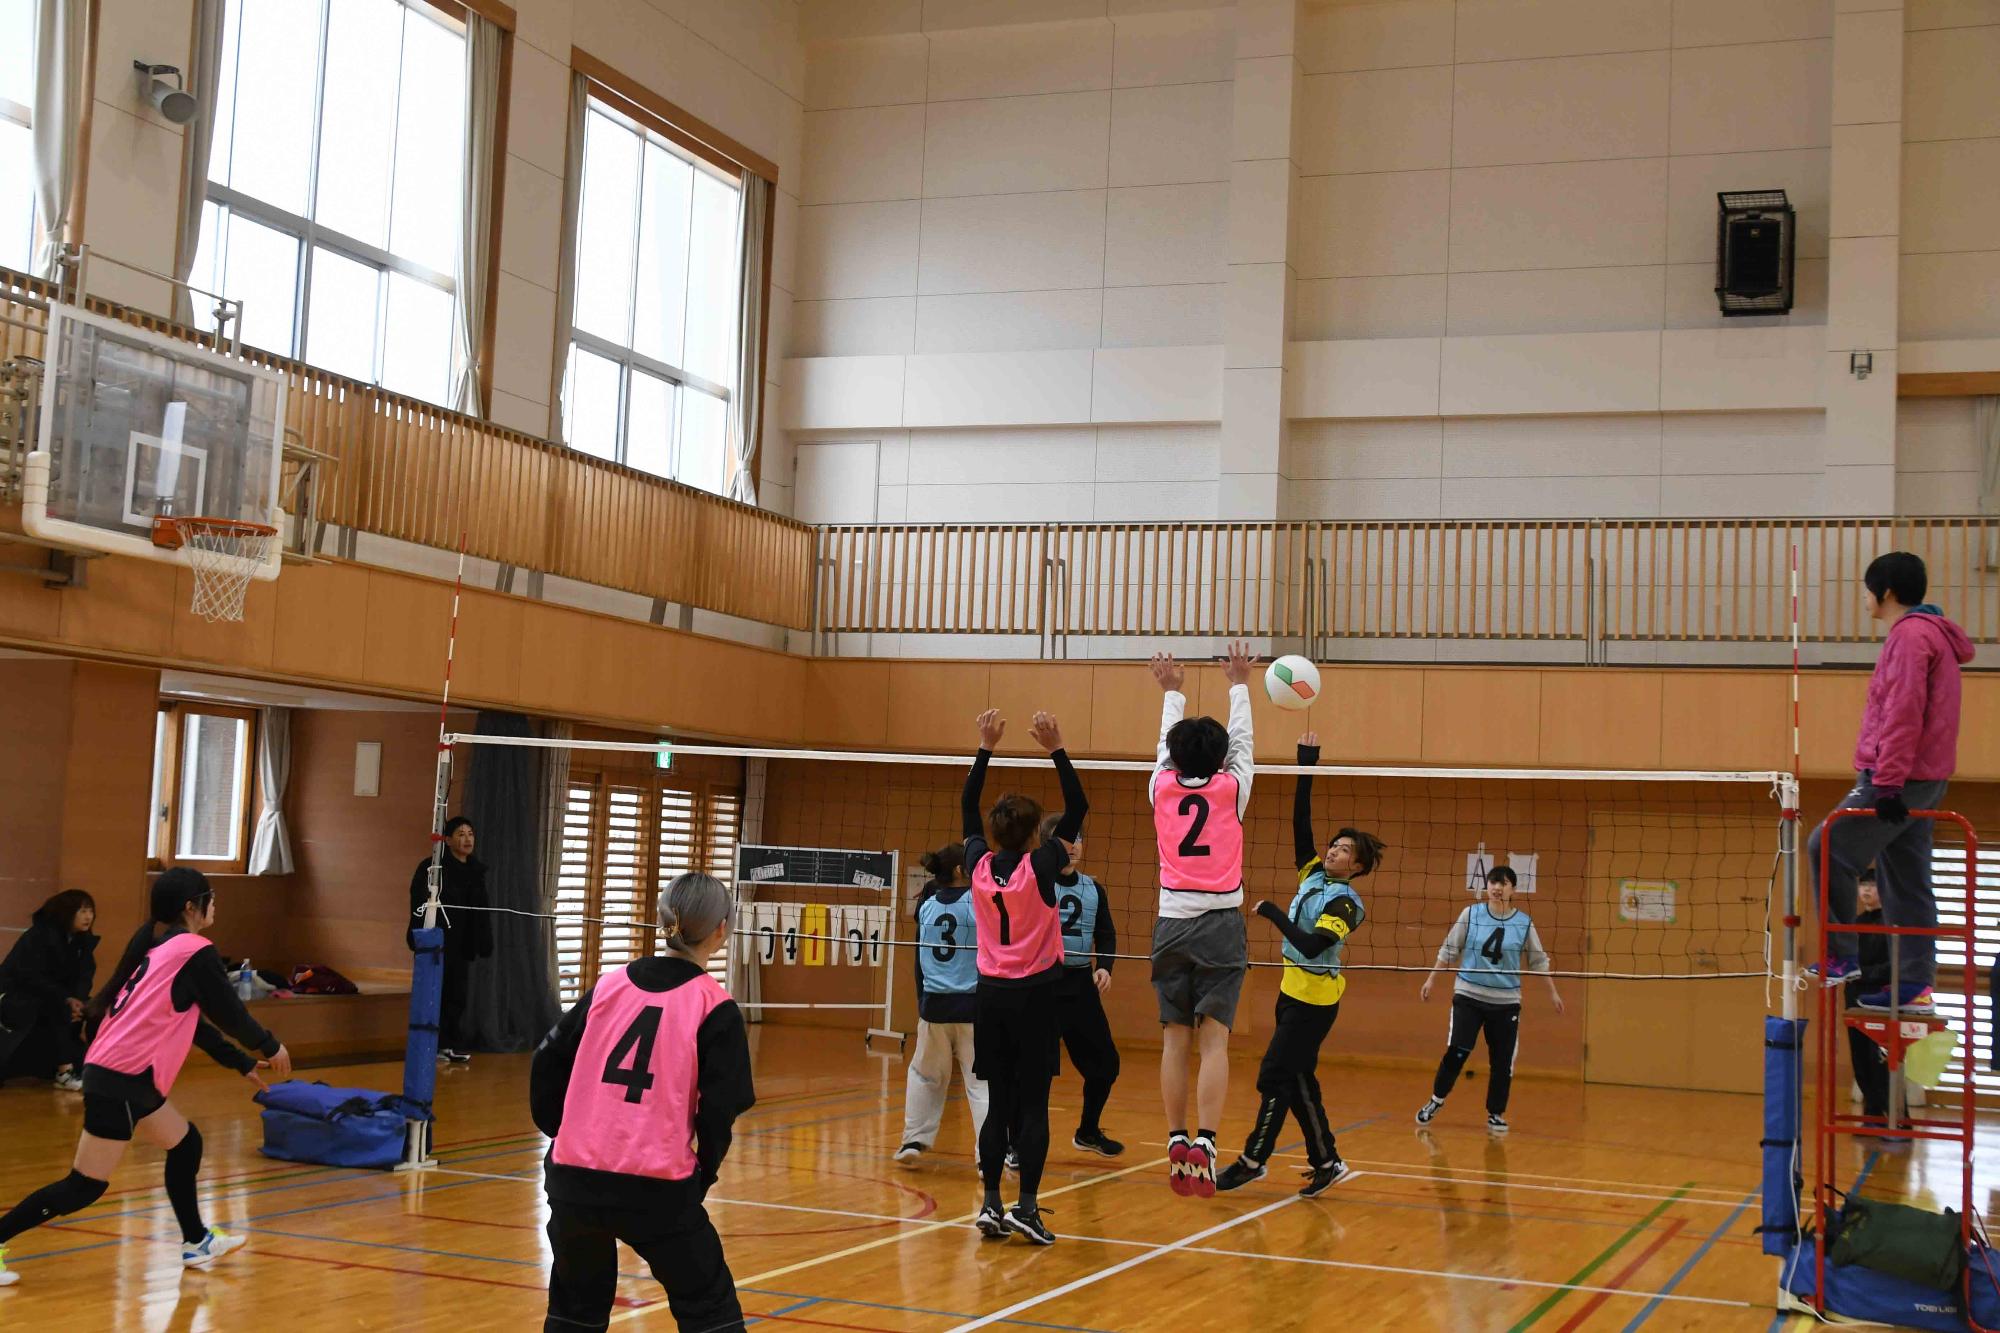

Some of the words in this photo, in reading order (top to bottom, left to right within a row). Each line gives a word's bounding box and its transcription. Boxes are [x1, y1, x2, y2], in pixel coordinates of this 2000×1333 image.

[1178, 794, 1210, 857] 2
[1468, 859, 1488, 889] A
[933, 913, 957, 962] 3
[992, 891, 1011, 945] 1
[1059, 895, 1082, 937] 2
[1481, 927, 1505, 965] 4
[601, 1005, 663, 1104] 4
